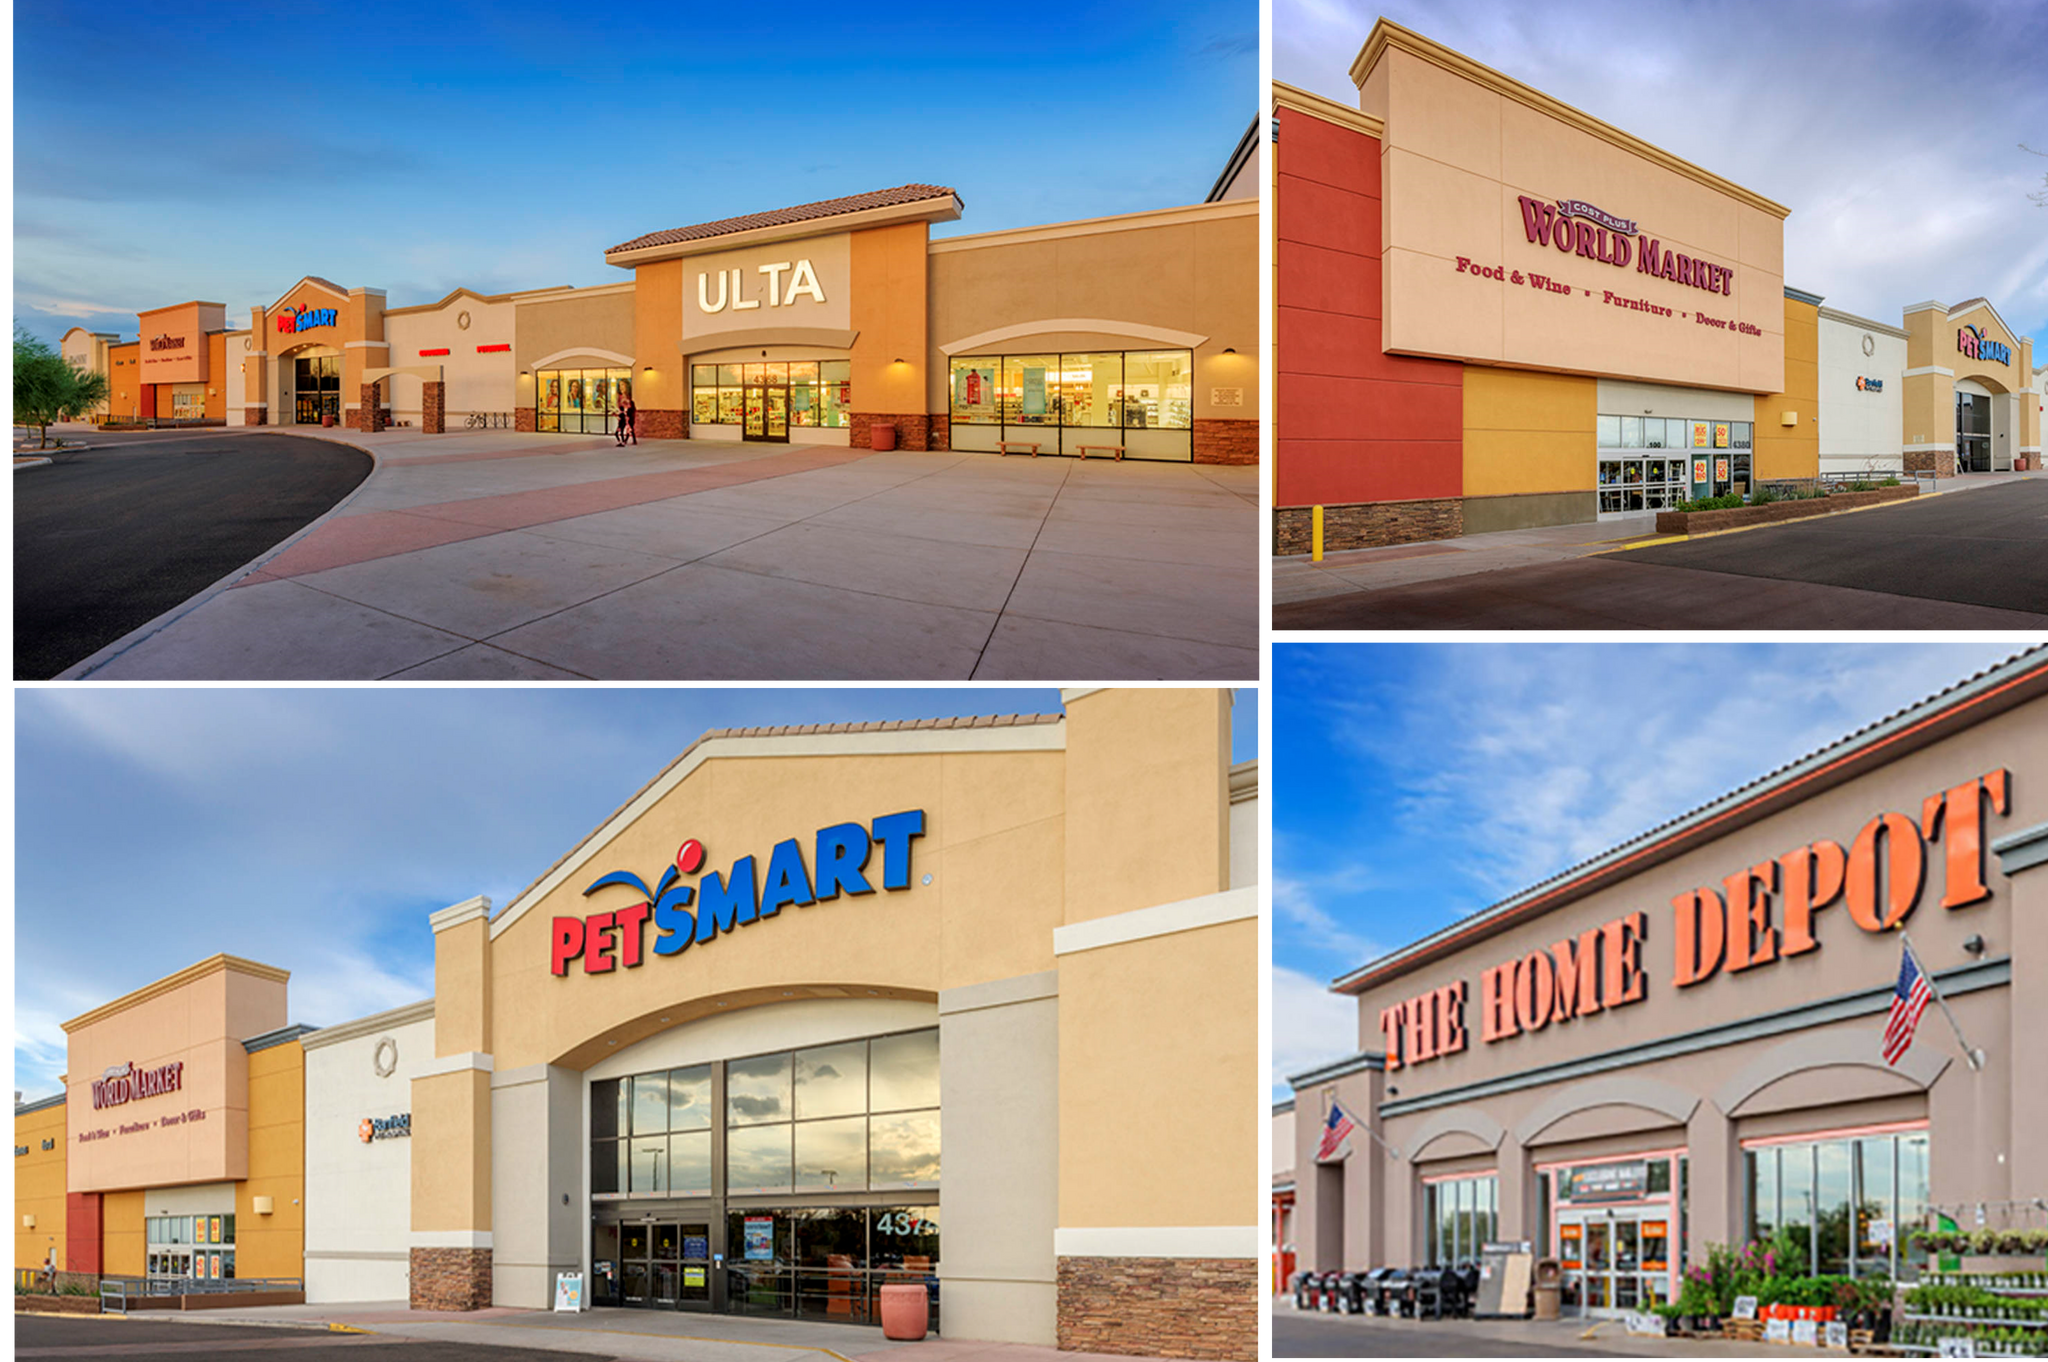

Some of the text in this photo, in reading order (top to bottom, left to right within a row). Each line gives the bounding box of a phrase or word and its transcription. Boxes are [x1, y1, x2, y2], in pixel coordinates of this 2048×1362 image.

[1573, 203, 1627, 229] COST PLUS
[1518, 196, 1733, 296] WORLD MARKET
[698, 259, 827, 313] ULTA
[1456, 256, 1762, 337] Food & Wine Furniture Decor & Gifts
[277, 308, 338, 333] PETSMART
[1958, 328, 2012, 367] PETSMART
[551, 809, 926, 977] PETSMART
[1379, 768, 2011, 1071] THE HOME DEPOT
[91, 1079, 130, 1110] WORLD
[130, 1061, 184, 1101] MARKET
